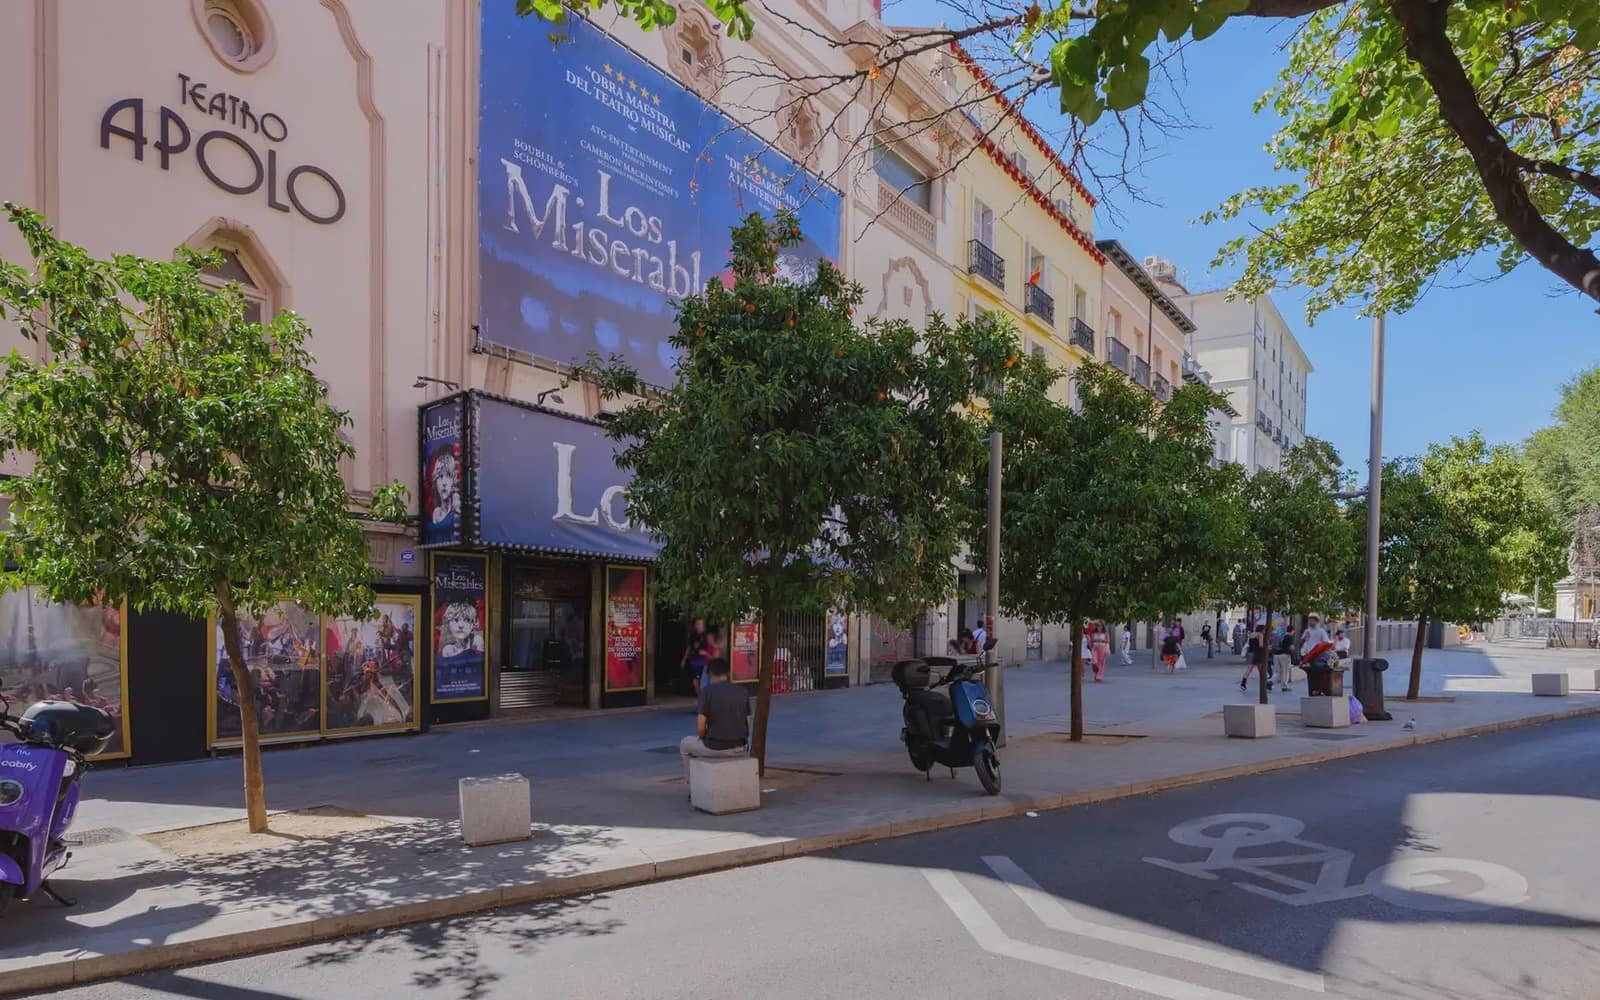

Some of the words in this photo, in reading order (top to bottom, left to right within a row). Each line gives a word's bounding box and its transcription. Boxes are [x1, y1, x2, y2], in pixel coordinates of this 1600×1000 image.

[177, 73, 288, 142] TEATRO
[566, 69, 592, 95] DEL
[593, 86, 639, 122] TEATRO
[626, 91, 676, 132] MAESTRA
[100, 98, 346, 224] APOLO
[514, 138, 556, 165] BOUBLIL
[557, 160, 566, 170] &
[580, 139, 622, 166] CAMERON
[608, 134, 672, 175] ENTERTAINMENT
[597, 169, 662, 244] Los
[500, 158, 709, 303] Miserabl
[552, 441, 647, 534] Lo
[451, 571, 467, 582] Los
[1, 760, 38, 771] cabify
